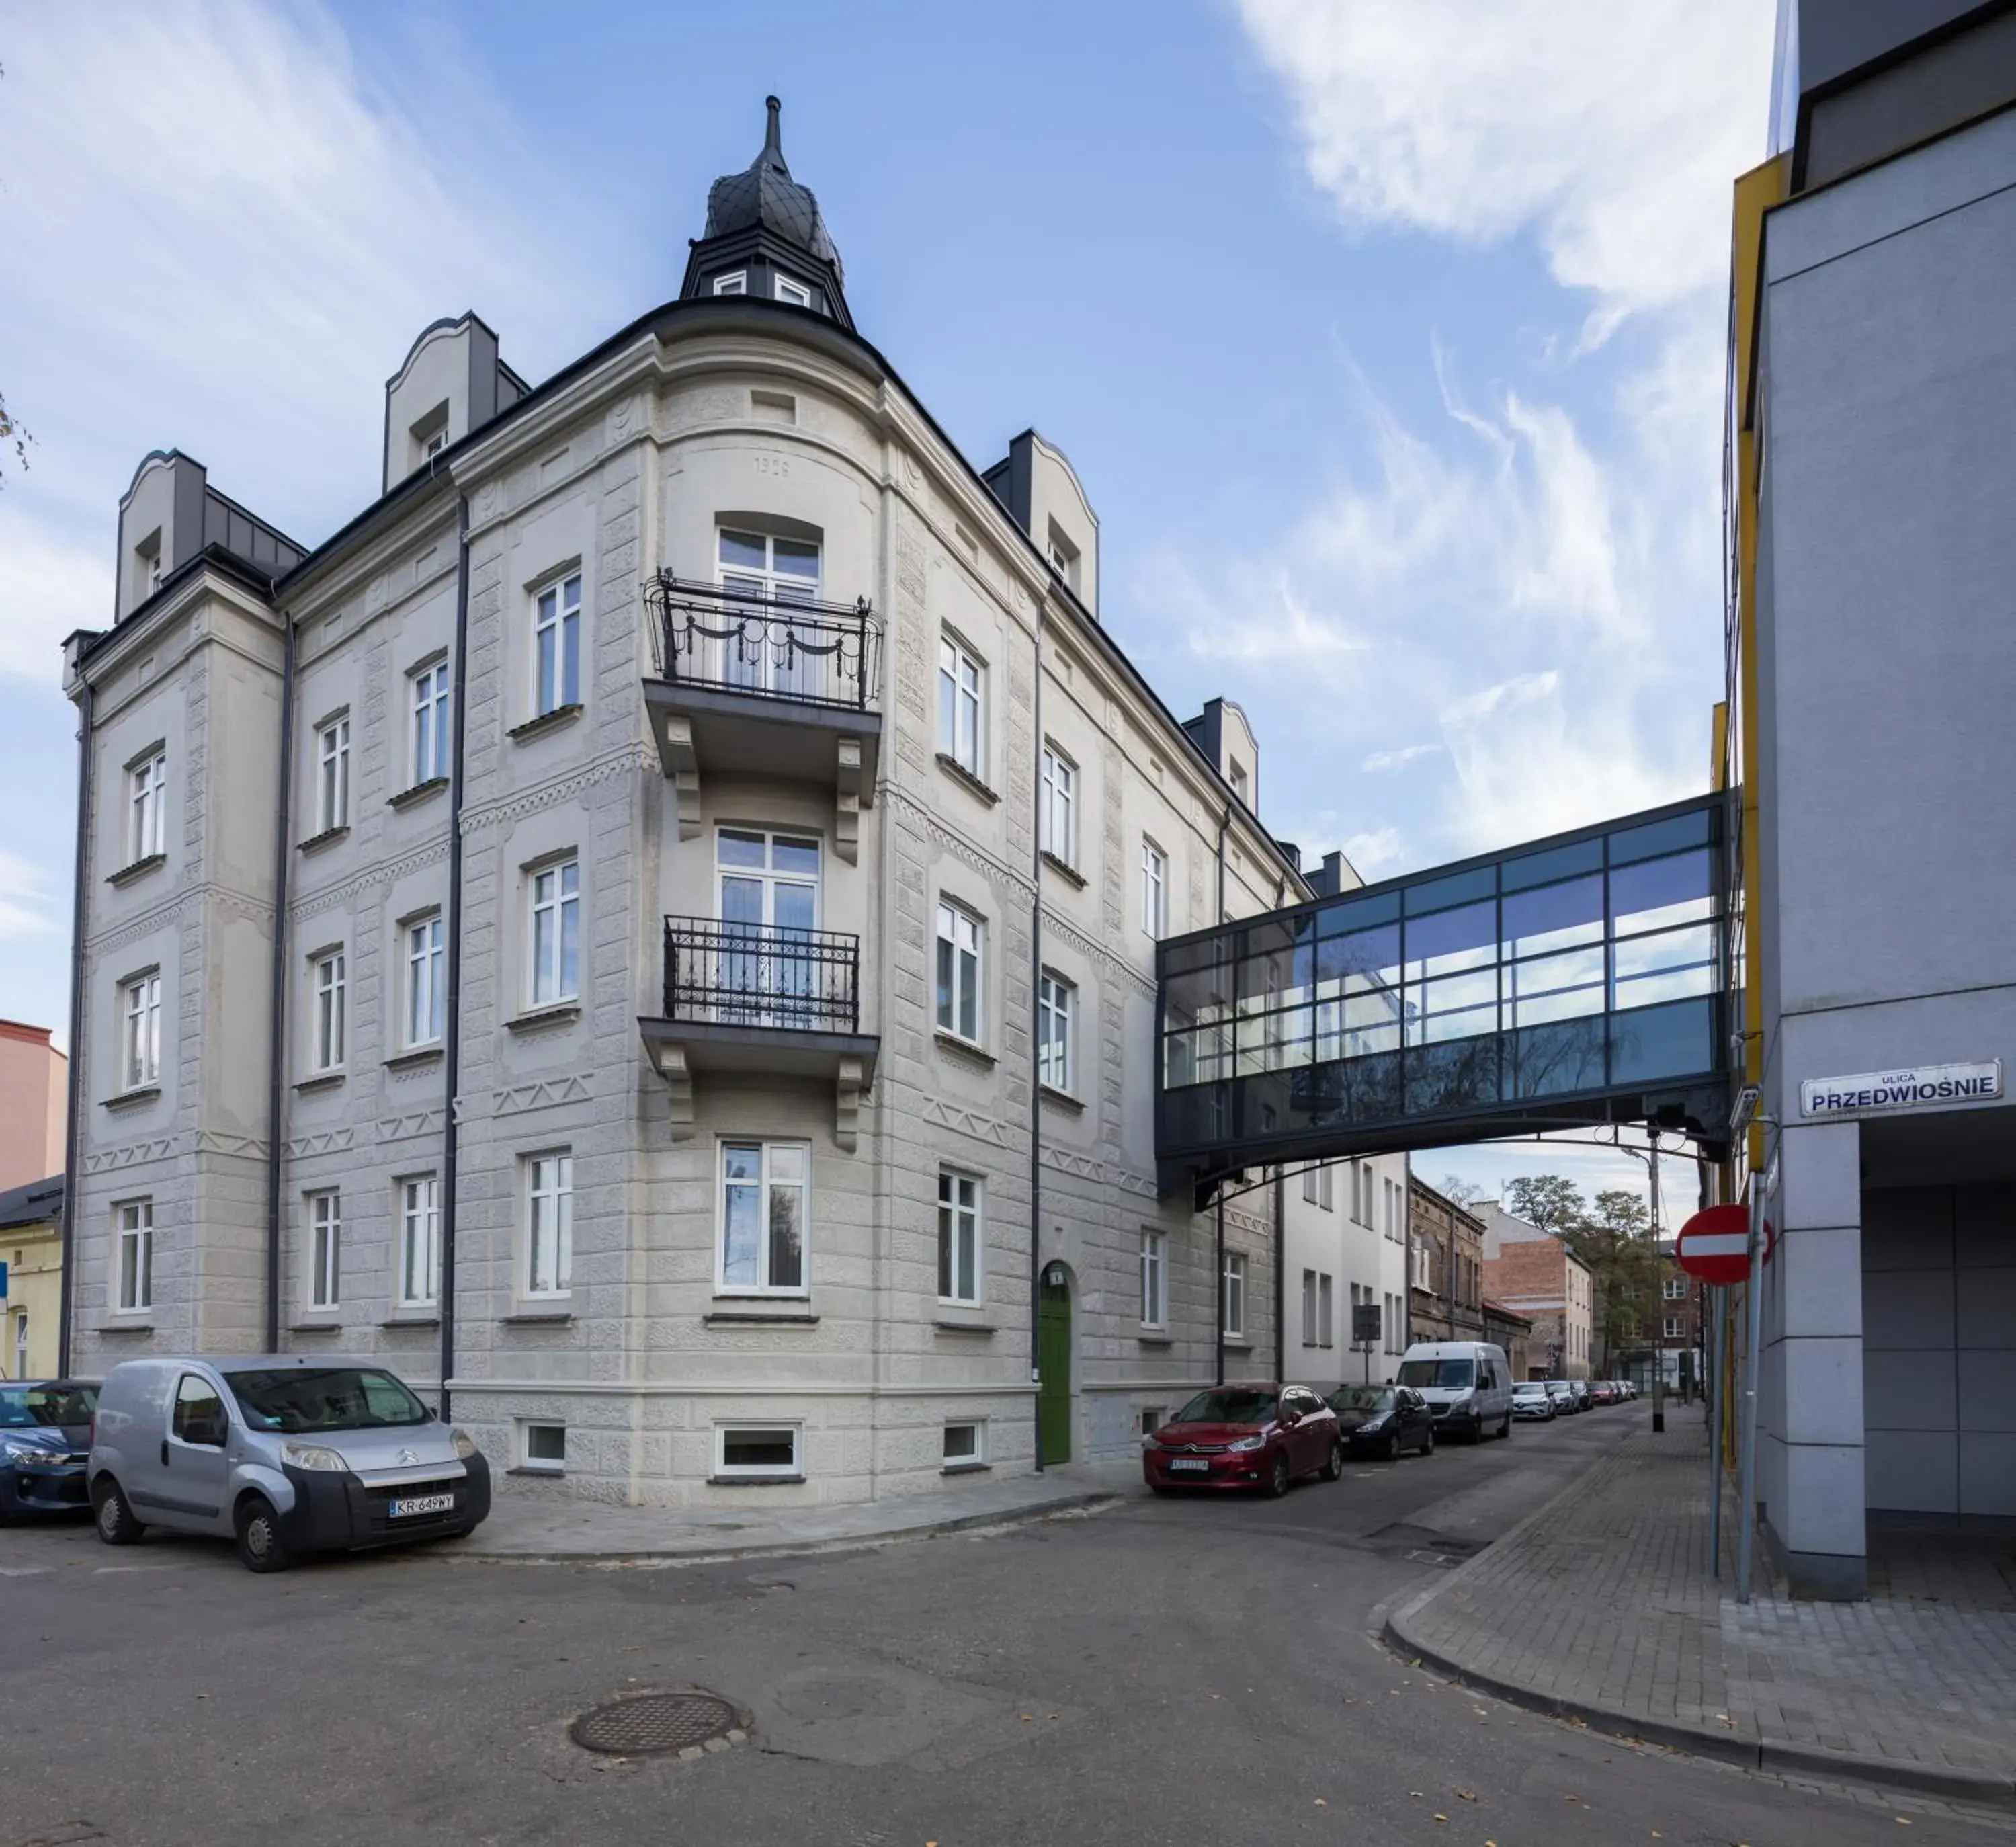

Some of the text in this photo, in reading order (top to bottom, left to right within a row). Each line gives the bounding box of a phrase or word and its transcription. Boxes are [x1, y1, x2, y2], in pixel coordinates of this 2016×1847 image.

[1882, 1073, 1916, 1085] ULICA
[1812, 1076, 1994, 1110] PRZEDWIOŚNIE
[397, 1501, 415, 1514] KR
